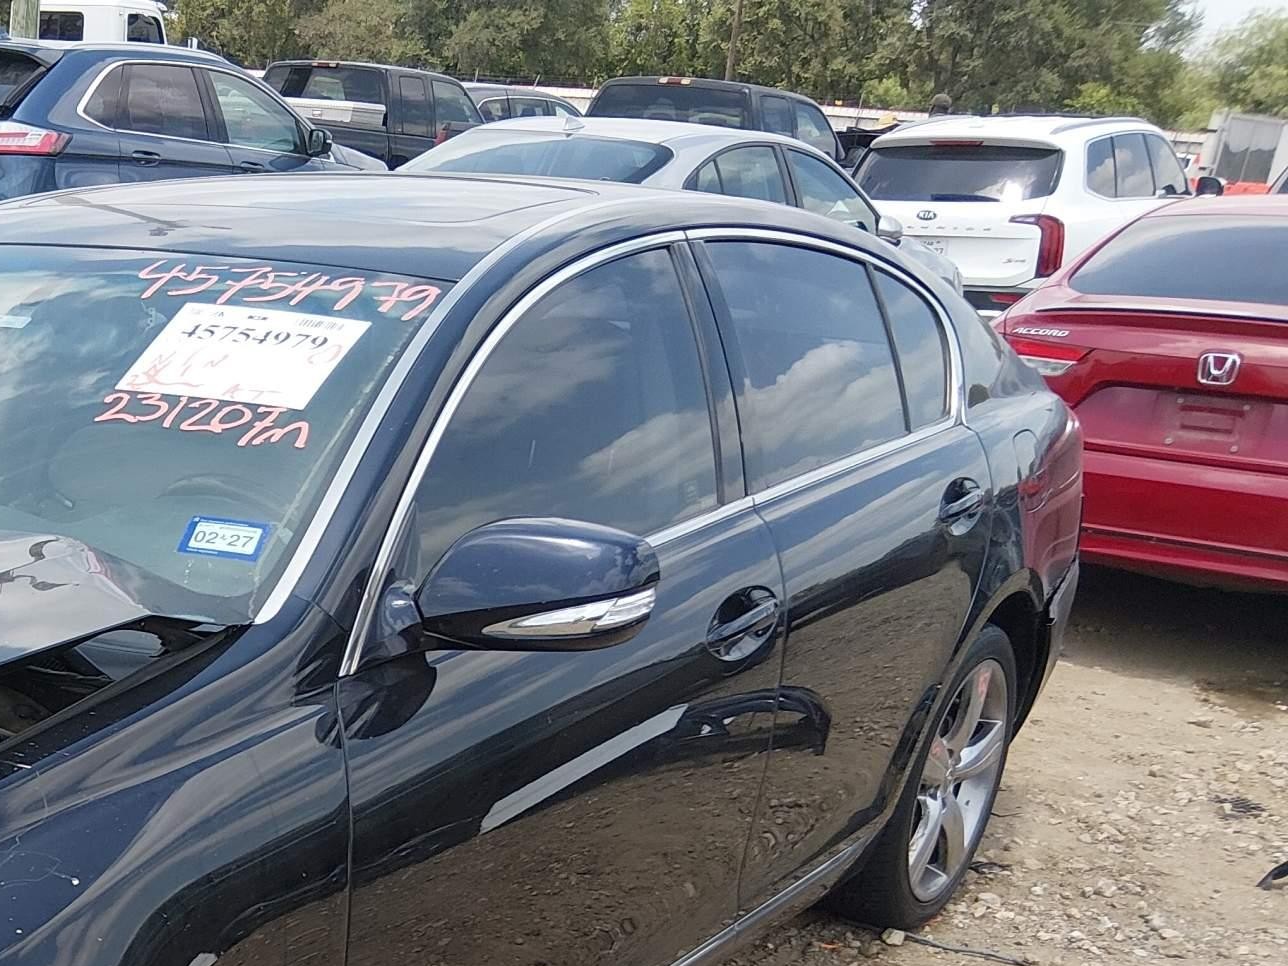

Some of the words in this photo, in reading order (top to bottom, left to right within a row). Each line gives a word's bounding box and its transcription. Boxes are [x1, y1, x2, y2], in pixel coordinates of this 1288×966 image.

[918, 211, 935, 219] KIA
[138, 259, 442, 321] 45754979
[181, 323, 328, 349] 45754979
[1012, 327, 1071, 337] ACCORD
